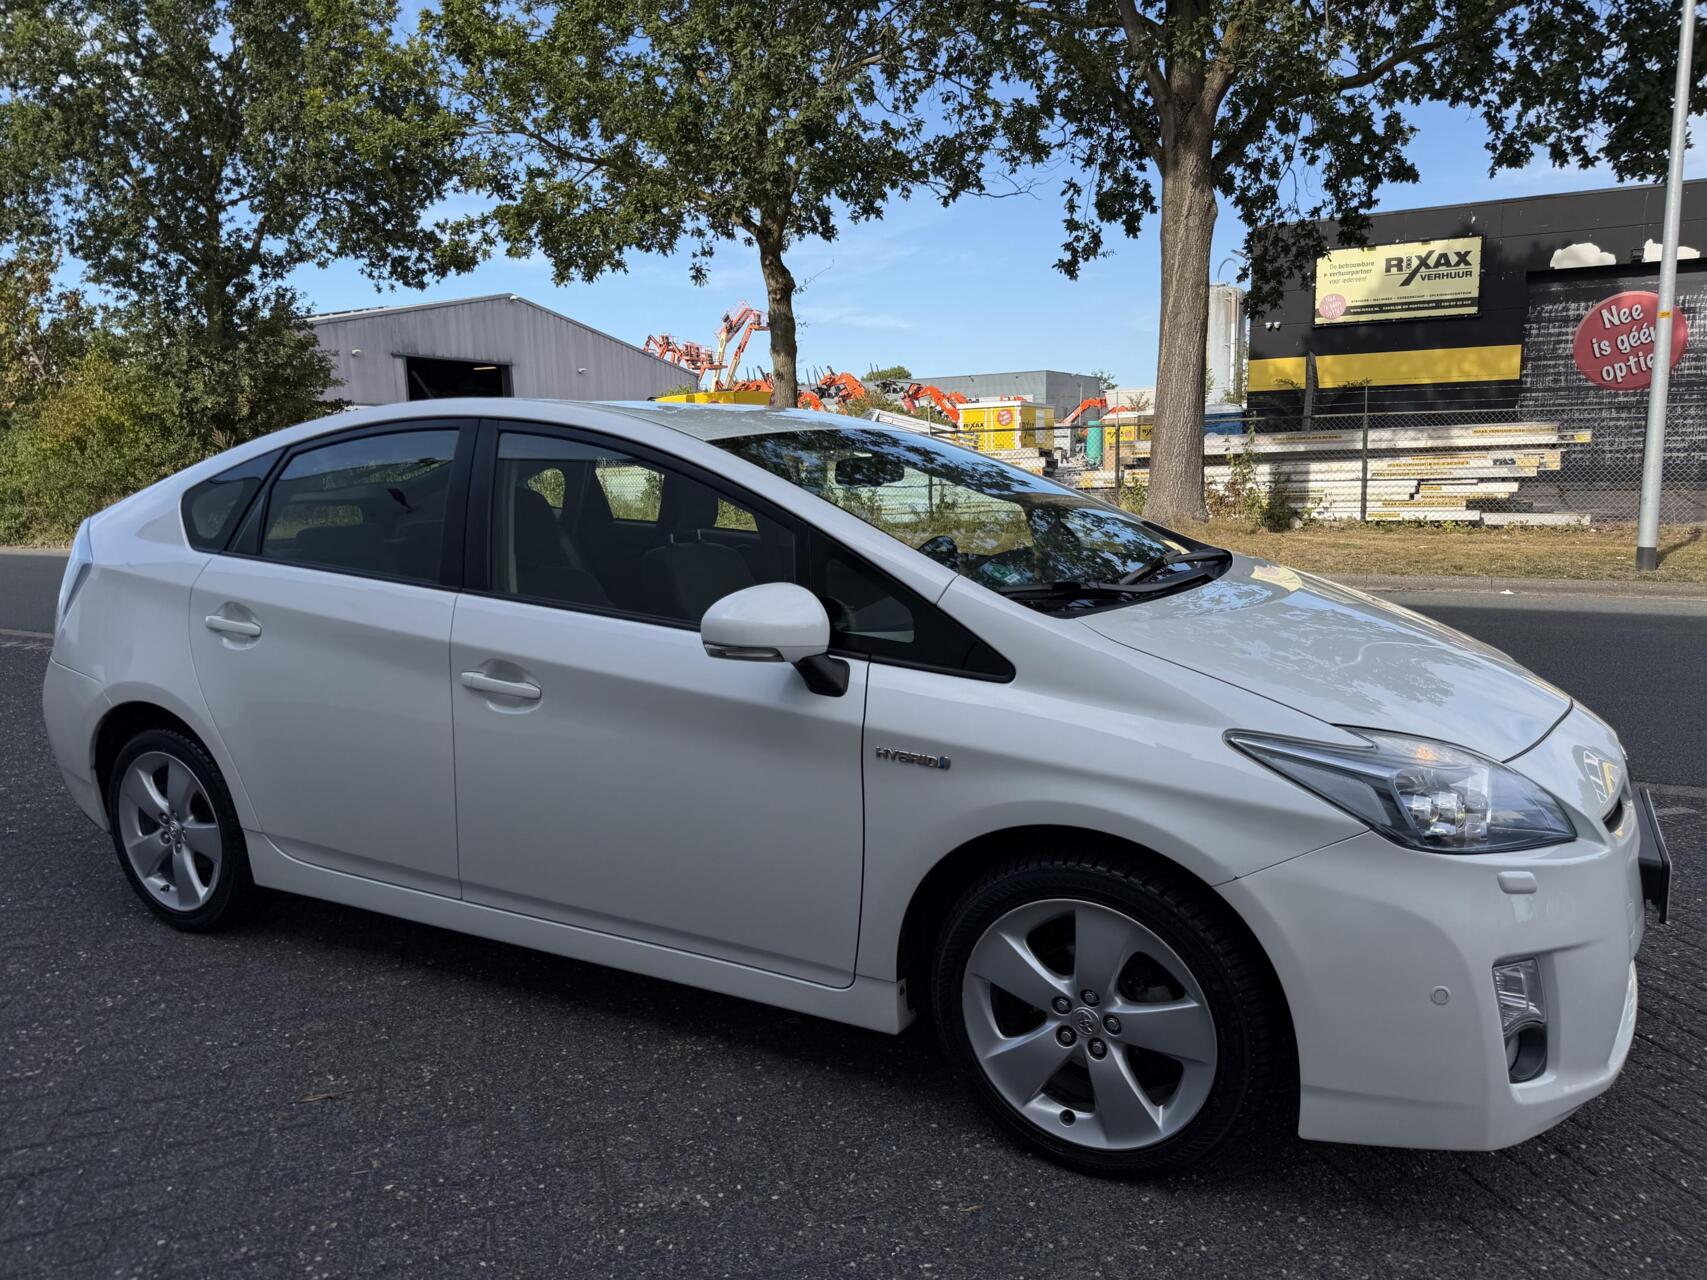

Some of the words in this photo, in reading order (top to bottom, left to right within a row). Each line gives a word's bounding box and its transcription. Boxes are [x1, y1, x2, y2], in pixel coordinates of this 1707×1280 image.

[1329, 269, 1373, 277] verhuurpartner
[1338, 261, 1375, 269] betrouwbare
[1420, 270, 1473, 281] VERHUUR
[1601, 304, 1644, 329] Nee
[1591, 337, 1612, 358] is
[876, 746, 939, 768] HYBRID
